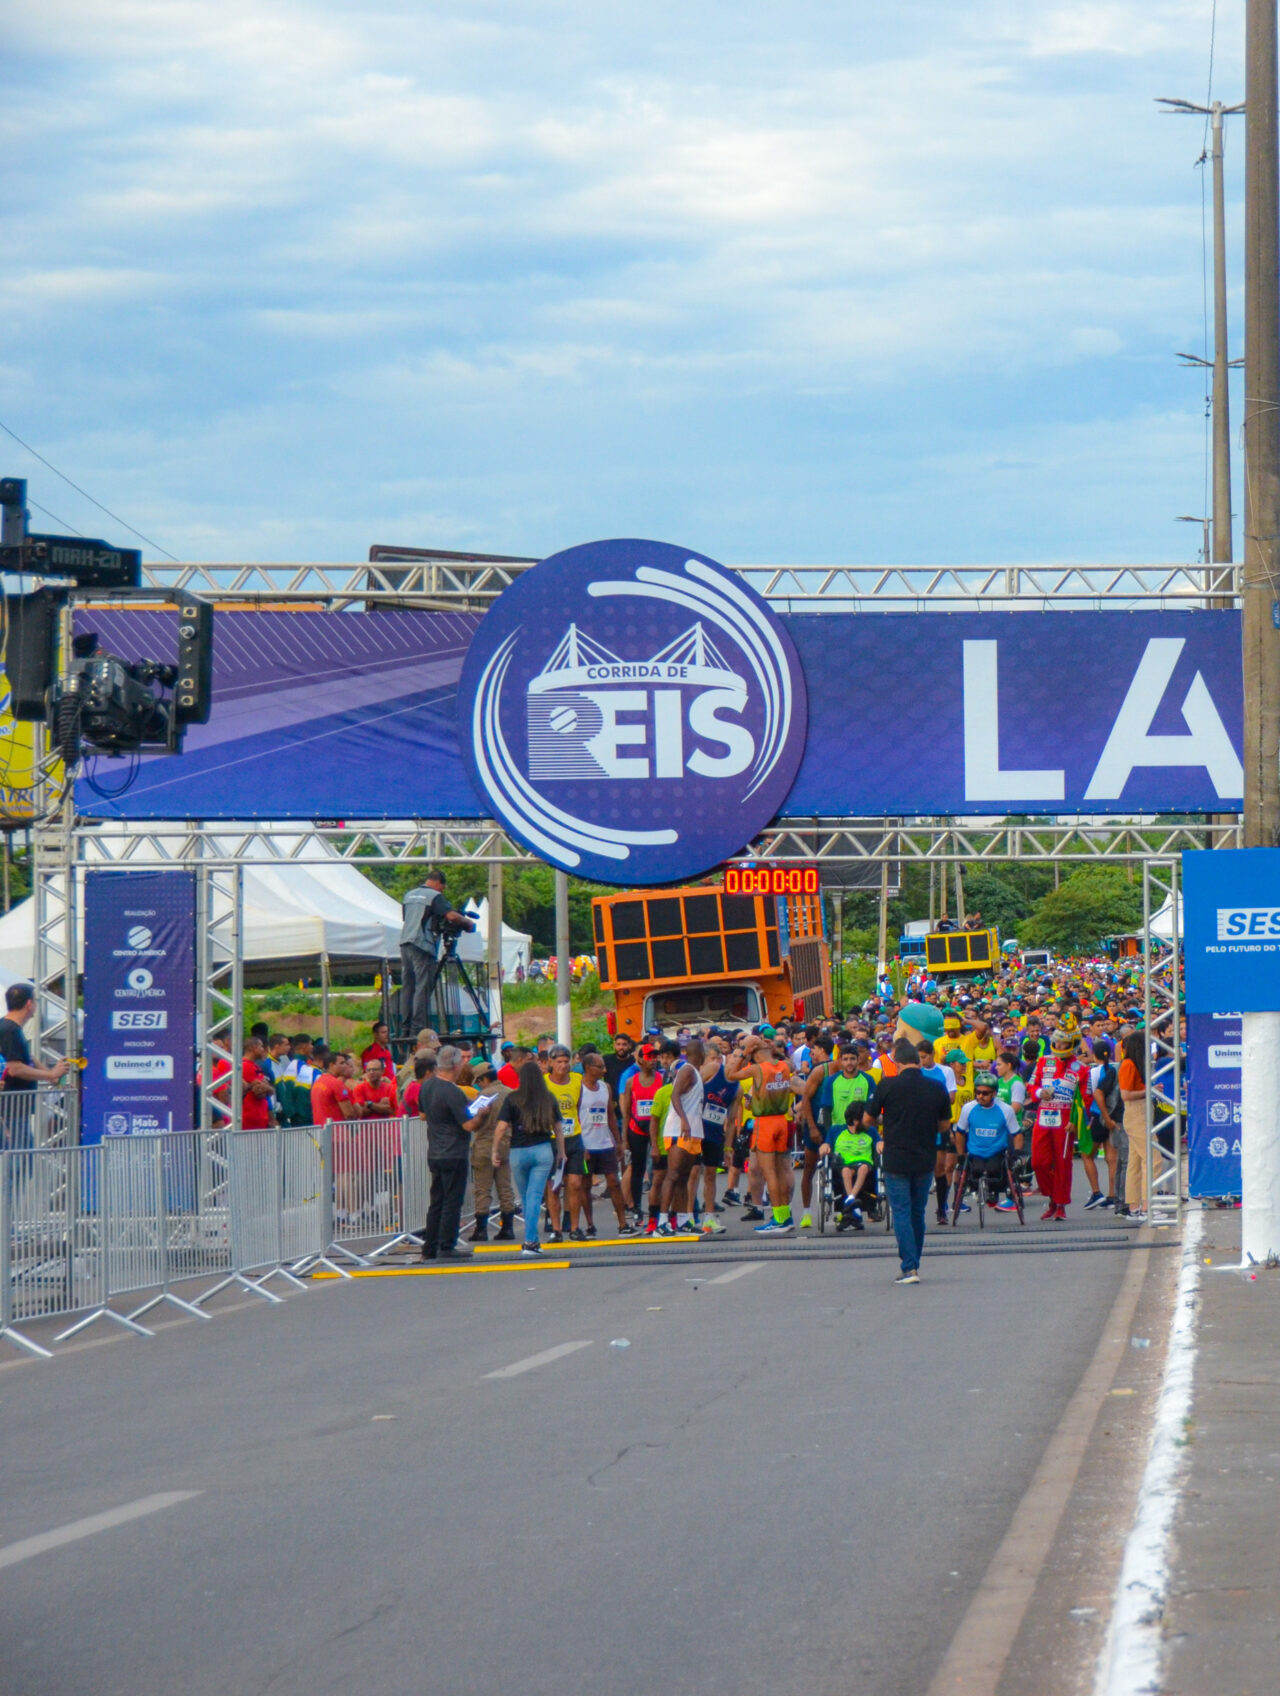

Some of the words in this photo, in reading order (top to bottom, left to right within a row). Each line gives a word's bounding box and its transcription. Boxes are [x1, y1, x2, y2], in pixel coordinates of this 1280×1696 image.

[587, 665, 662, 679] CORRIDA
[667, 666, 688, 678] DE
[527, 688, 755, 780] REIS
[726, 870, 818, 893] 00:00:00
[1205, 945, 1227, 953] PELO
[1263, 944, 1276, 952] DO
[118, 1013, 162, 1027] SESI
[114, 1060, 152, 1069] Unimed
[132, 1118, 159, 1127] Mato
